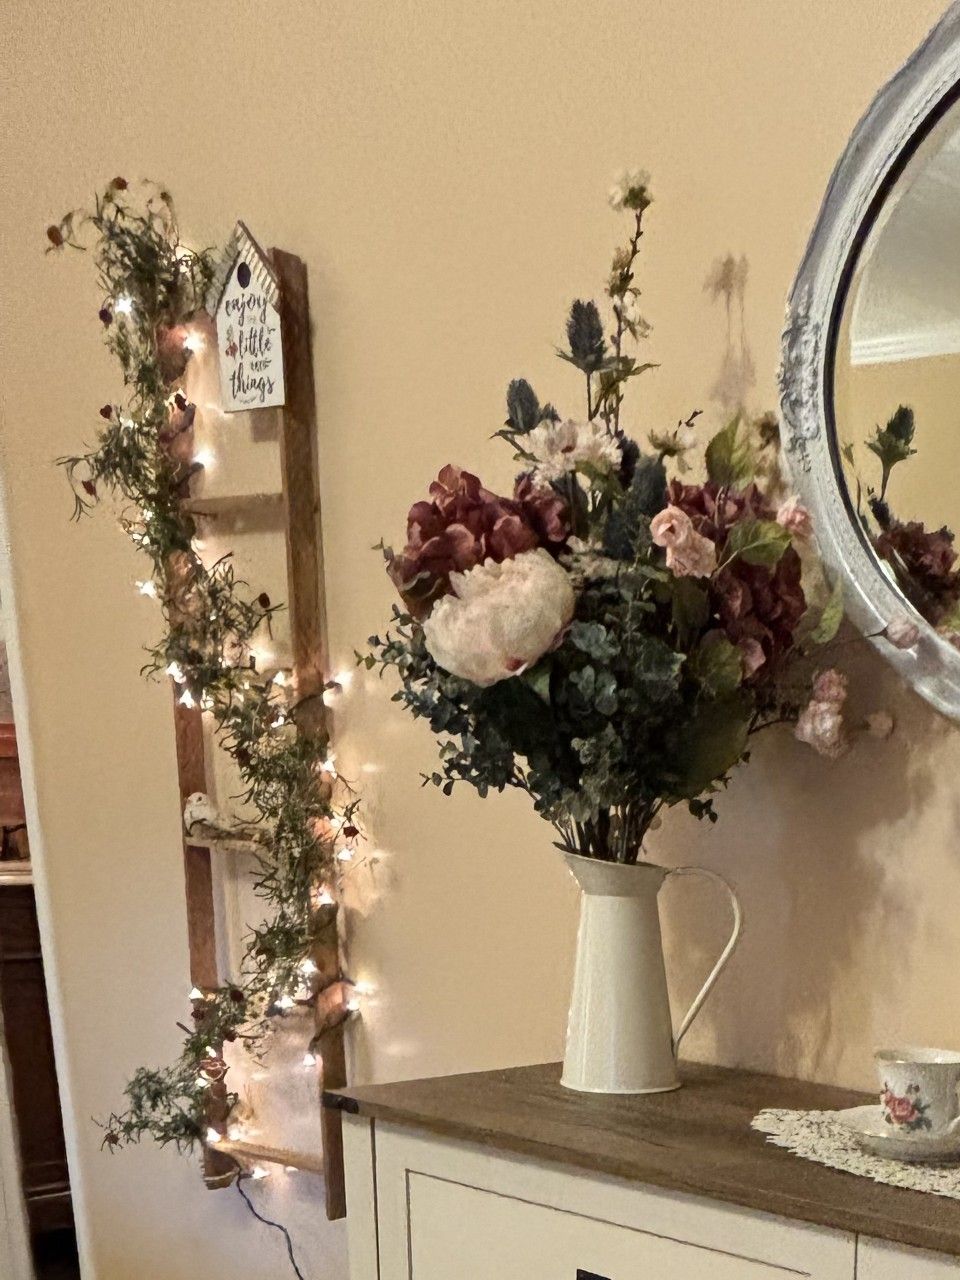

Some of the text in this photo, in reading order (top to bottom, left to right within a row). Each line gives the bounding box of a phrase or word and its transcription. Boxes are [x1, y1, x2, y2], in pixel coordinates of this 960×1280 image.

[225, 293, 267, 327] enjoy
[239, 326, 272, 359] little
[229, 362, 275, 402] things
